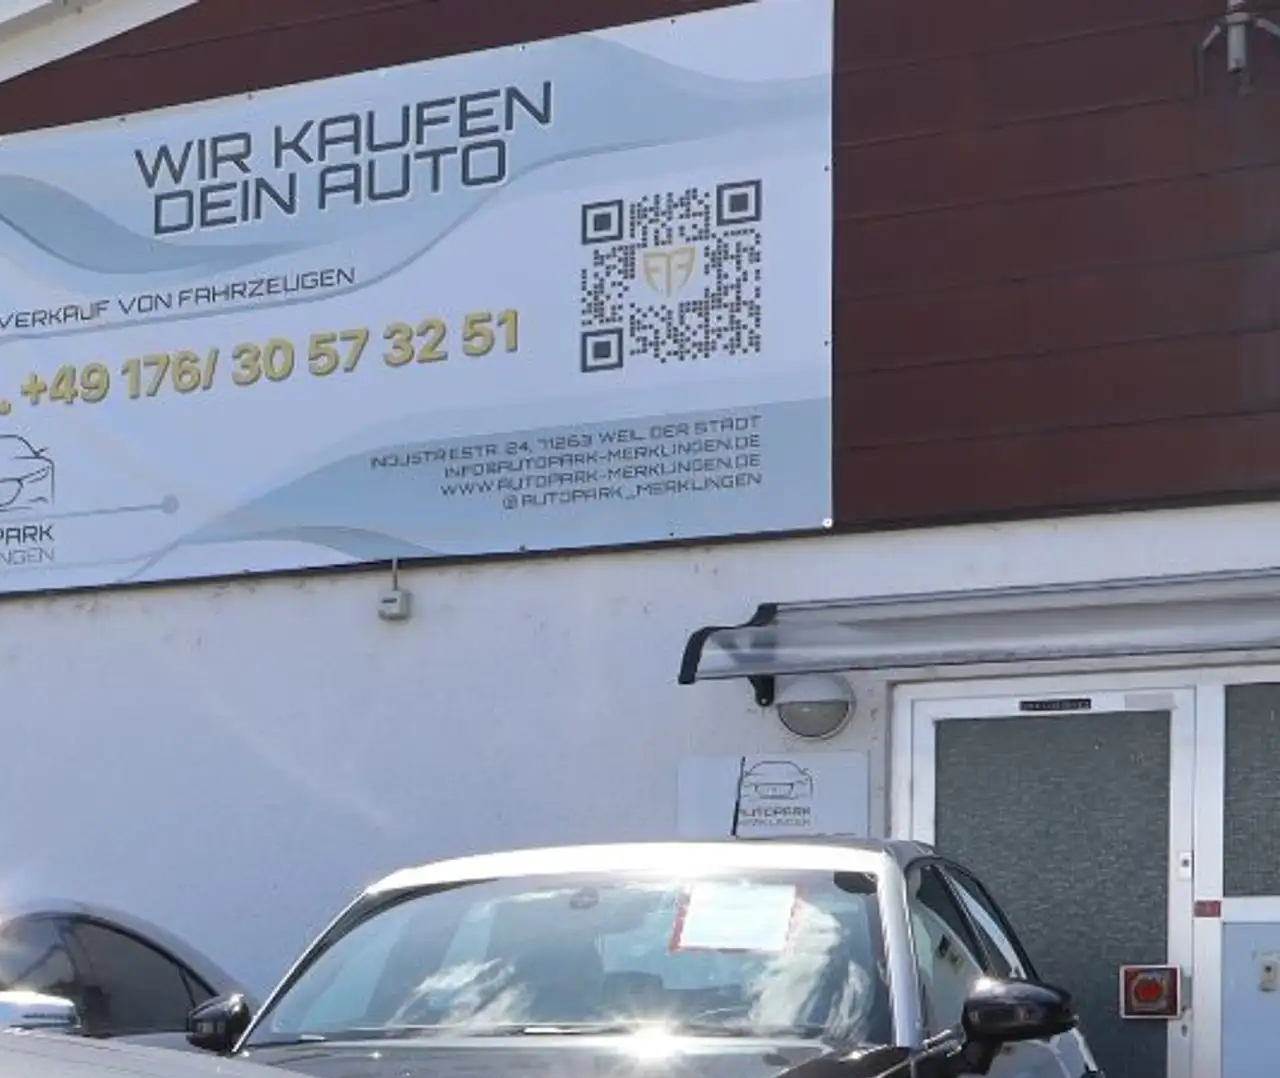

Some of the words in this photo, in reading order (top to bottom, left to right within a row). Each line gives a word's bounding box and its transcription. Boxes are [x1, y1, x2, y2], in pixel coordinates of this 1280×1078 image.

[134, 131, 252, 188] WIR
[274, 81, 552, 169] KAUFEN
[153, 172, 298, 235] DEIN
[318, 139, 507, 209] AUTO
[118, 293, 172, 315] VON
[177, 267, 356, 307] FAHRZEUGEN
[20, 363, 109, 405] +49
[120, 347, 220, 399] 176/
[231, 338, 295, 386] 30
[307, 328, 369, 376] 57
[382, 318, 448, 367] 32
[461, 308, 519, 356] 51
[536, 434, 592, 451] 71263
[598, 428, 645, 445] WEIL
[650, 422, 689, 439] DER
[693, 415, 762, 434] STADT
